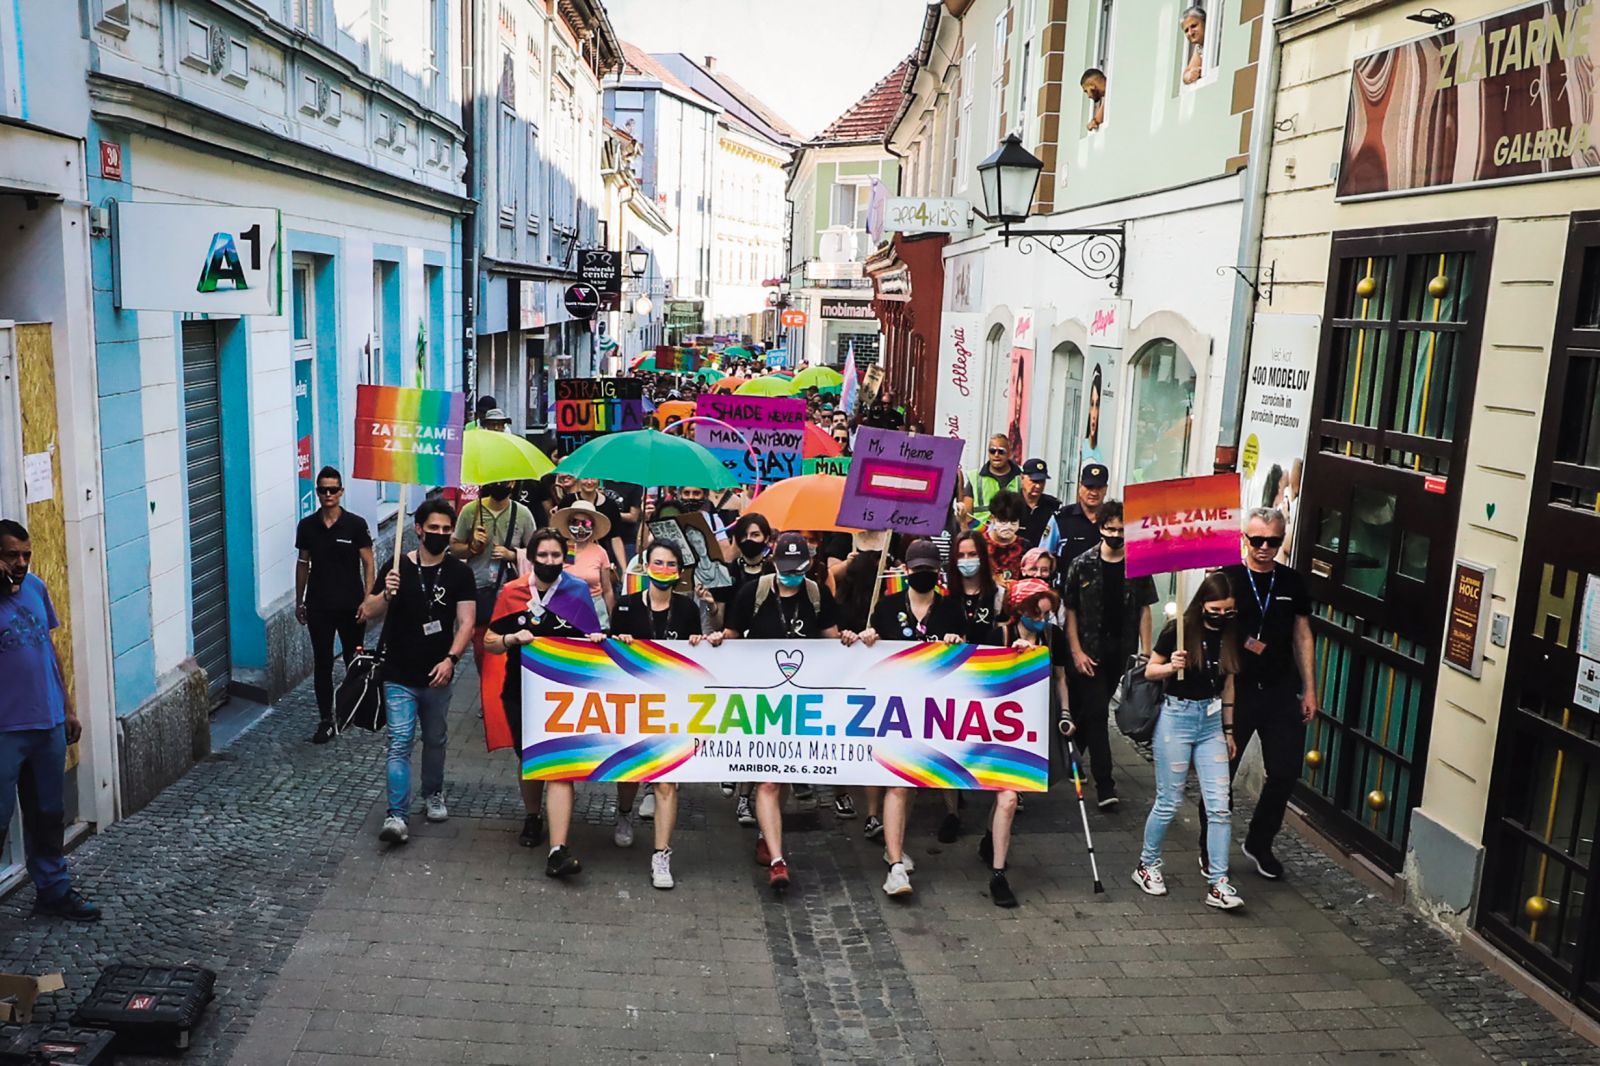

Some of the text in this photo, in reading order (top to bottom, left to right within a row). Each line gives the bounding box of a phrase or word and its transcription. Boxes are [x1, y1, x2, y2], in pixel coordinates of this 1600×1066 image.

[1435, 4, 1594, 90] ZLATARNE
[1494, 123, 1591, 167] GALERIJA
[107, 147, 118, 167] 30
[197, 223, 261, 293] A1
[582, 271, 615, 279] center
[951, 327, 972, 397] Allegria
[1252, 366, 1310, 391] 400 MODELOV
[708, 402, 804, 422] SHADE NEVER
[371, 423, 459, 440] ZATE. ZAME.
[710, 430, 802, 450] MADE ANYBODY
[384, 439, 445, 456] ZA NAS.
[868, 438, 934, 460] My theme
[744, 447, 796, 478] GAY
[816, 461, 852, 475] MAL
[863, 508, 874, 521] is
[1141, 507, 1232, 529] ZATE. ZAME.
[1153, 529, 1174, 543] ZA
[1459, 582, 1480, 599] HOLC
[545, 691, 1037, 743] ZATE. ZAME. ZA NAS.
[694, 737, 873, 762] PARADA PONOSA MARIBOR
[728, 764, 837, 775] MARIBOR, 26. 6. 2021
